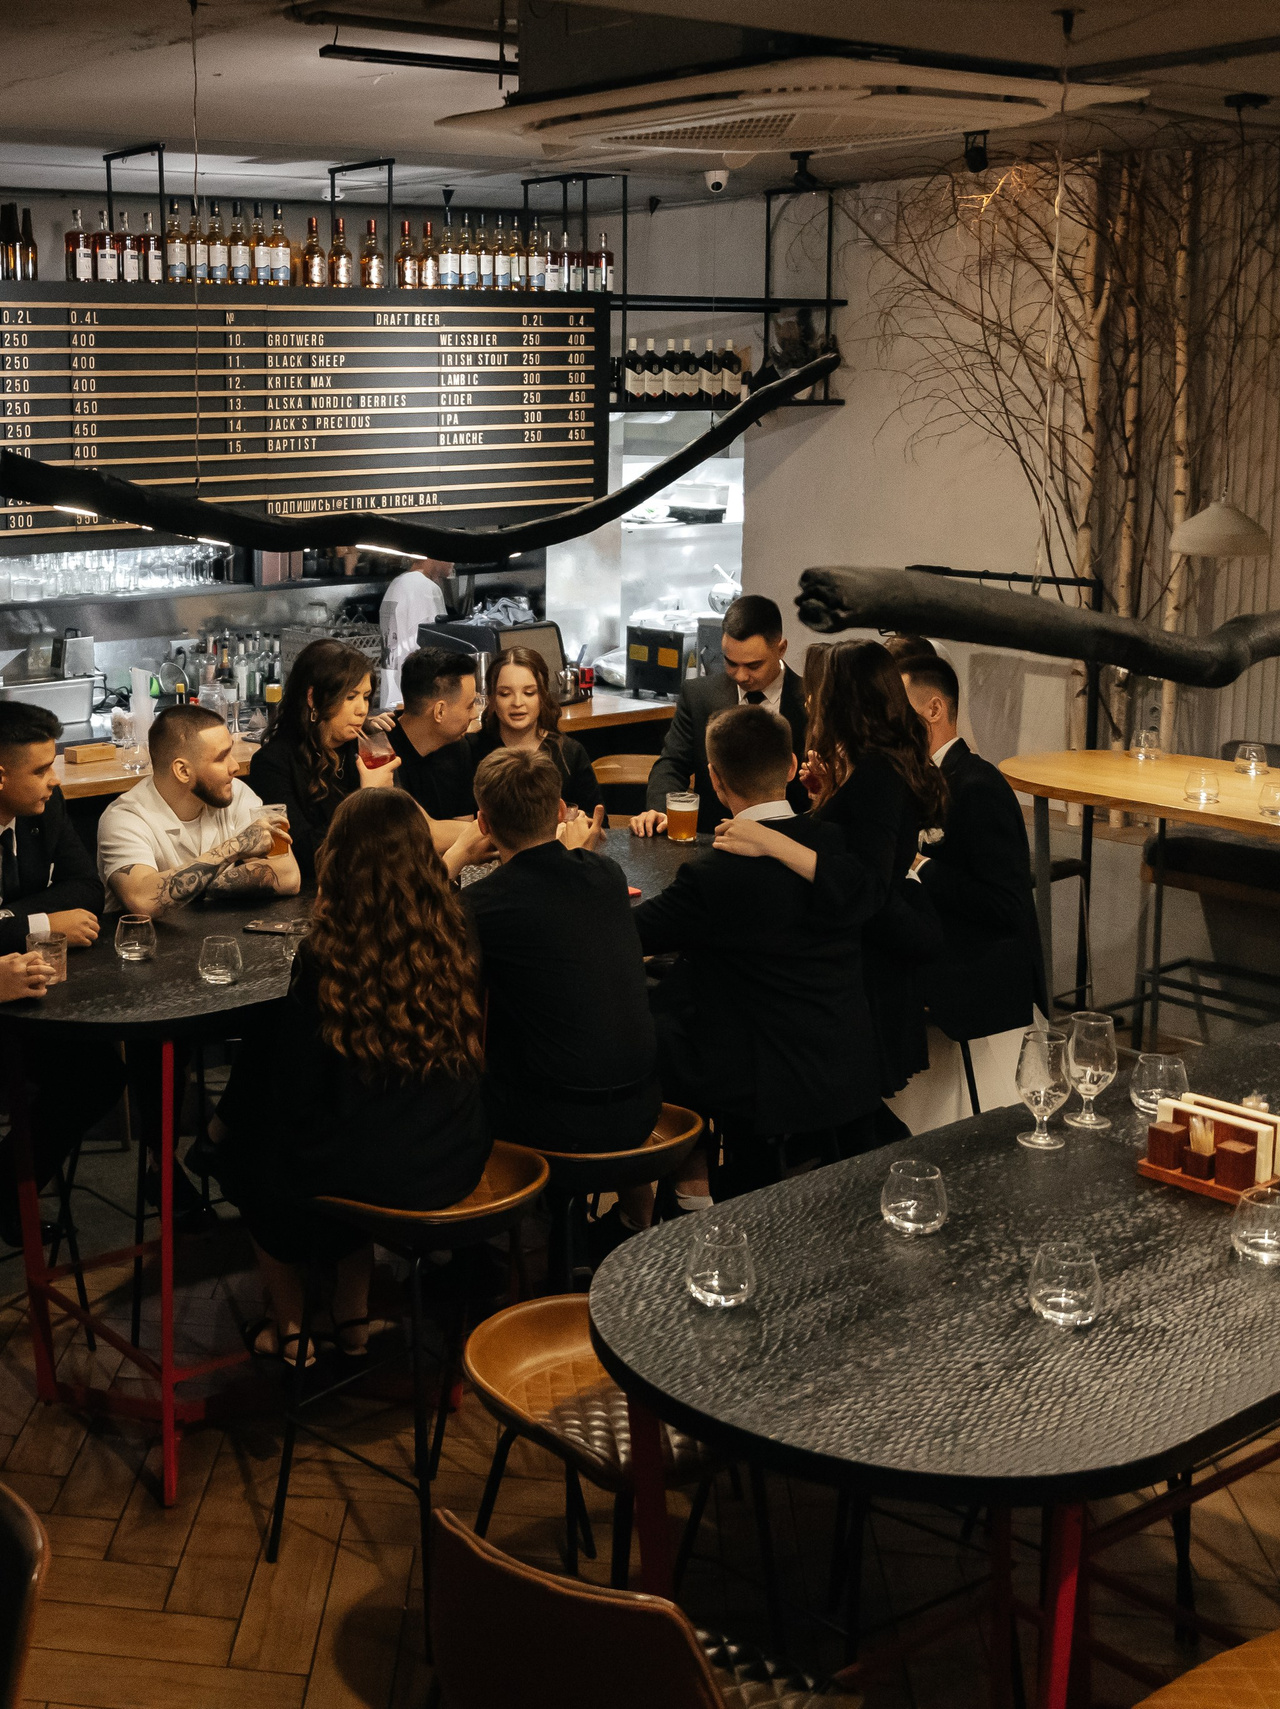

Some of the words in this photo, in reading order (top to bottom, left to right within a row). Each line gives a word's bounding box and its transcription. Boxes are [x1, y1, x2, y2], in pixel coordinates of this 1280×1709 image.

[3, 310, 32, 324] 0.2L
[70, 310, 99, 324] 0.4L
[376, 313, 409, 326] DRAFT
[414, 313, 440, 326] BEER
[522, 314, 544, 326] 0.2L
[4, 333, 28, 347] 250
[72, 333, 96, 347] 400
[228, 334, 246, 346] 10.
[267, 334, 325, 347] GROTWERG
[440, 334, 498, 346] WEISSBIER
[522, 334, 540, 346] 250
[567, 334, 585, 346] 400
[5, 356, 30, 370] 250
[72, 356, 96, 370] 400
[228, 355, 246, 368] 11.
[267, 355, 303, 368] BLACK
[311, 354, 346, 368] SHEEP
[441, 353, 473, 366] IRISH
[477, 352, 509, 366] STOUT
[522, 353, 540, 365] 250
[567, 352, 585, 364] 400
[5, 379, 30, 393] 250
[73, 378, 96, 392] 400
[228, 377, 246, 389] 12.
[267, 376, 303, 390] KRIEK
[310, 376, 332, 388] MAX
[441, 373, 479, 386] LAMBIC
[523, 372, 541, 384] 300
[568, 372, 586, 384] 500
[229, 398, 247, 410] 13.
[267, 396, 303, 410] ALSKA
[311, 396, 353, 409] NORDIC
[360, 394, 407, 408] BERRIES
[440, 392, 473, 406] CIDER
[523, 392, 541, 404] 250
[568, 391, 586, 403] 450
[6, 402, 31, 416] 250
[75, 401, 98, 415] 450
[229, 419, 247, 432] 14.
[316, 416, 371, 429] PRECIOUS
[441, 413, 460, 426] IPA
[523, 411, 542, 423] 300
[568, 410, 586, 422] 450
[7, 424, 32, 439] 250
[74, 424, 98, 437] 450
[228, 440, 247, 453] 15.
[268, 438, 318, 451] BAPTIST
[439, 432, 484, 446] BLANCHE
[524, 430, 542, 442] 250
[568, 428, 586, 441] 450
[74, 446, 98, 459] 400
[9, 514, 33, 529] 300
